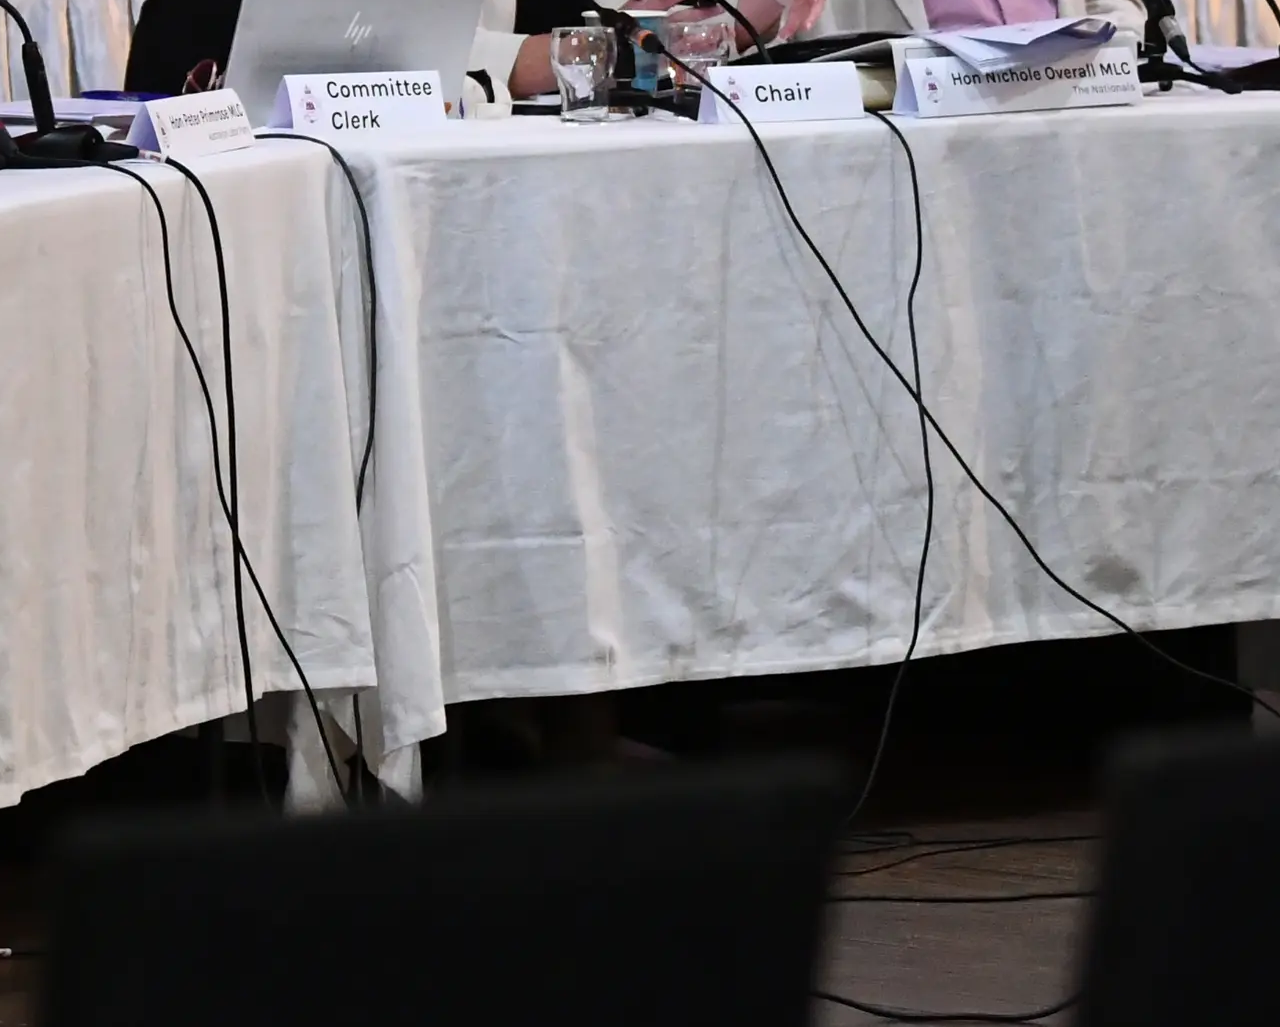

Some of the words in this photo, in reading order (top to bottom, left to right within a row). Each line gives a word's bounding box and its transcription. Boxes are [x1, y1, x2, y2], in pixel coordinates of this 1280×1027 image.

[952, 72, 982, 86] Hon
[985, 67, 1042, 84] Nichole
[1044, 63, 1097, 81] Overall
[1099, 62, 1132, 76] MLC
[326, 77, 432, 99] Committee
[754, 82, 812, 103] Chair
[1072, 85, 1090, 95] The
[1091, 83, 1136, 94] Nationals
[331, 109, 381, 130] Clerk
